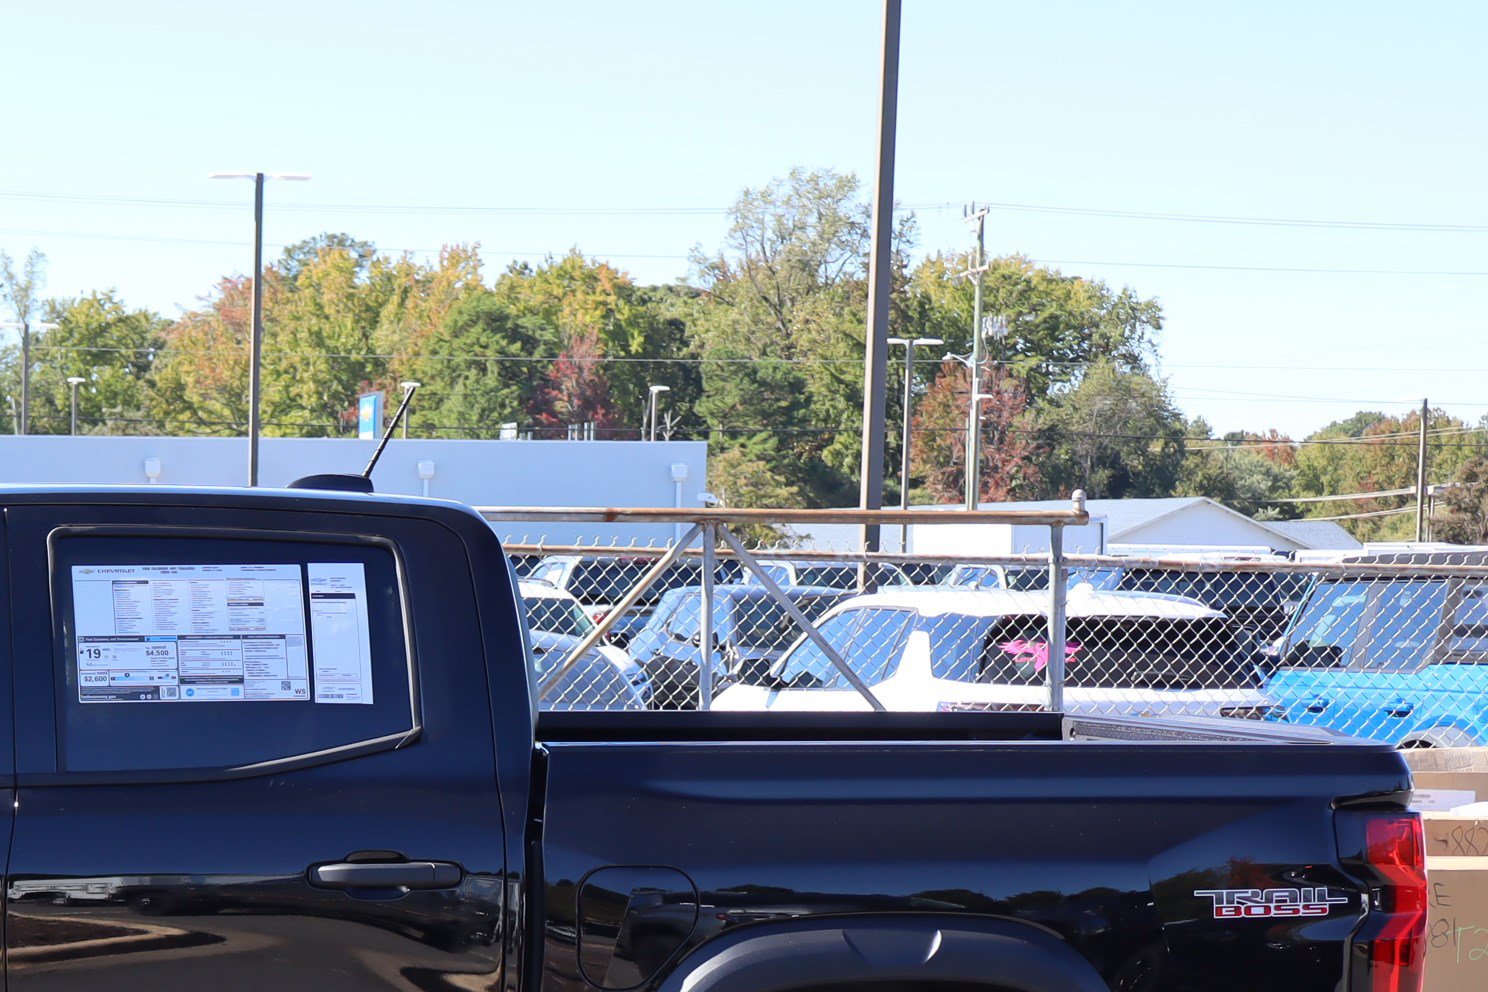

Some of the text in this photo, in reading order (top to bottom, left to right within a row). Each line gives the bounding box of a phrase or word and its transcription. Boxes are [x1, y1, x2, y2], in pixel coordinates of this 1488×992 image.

[86, 648, 101, 659] 19
[1194, 888, 1348, 906] TRAIL
[1214, 903, 1330, 919] BOSS
